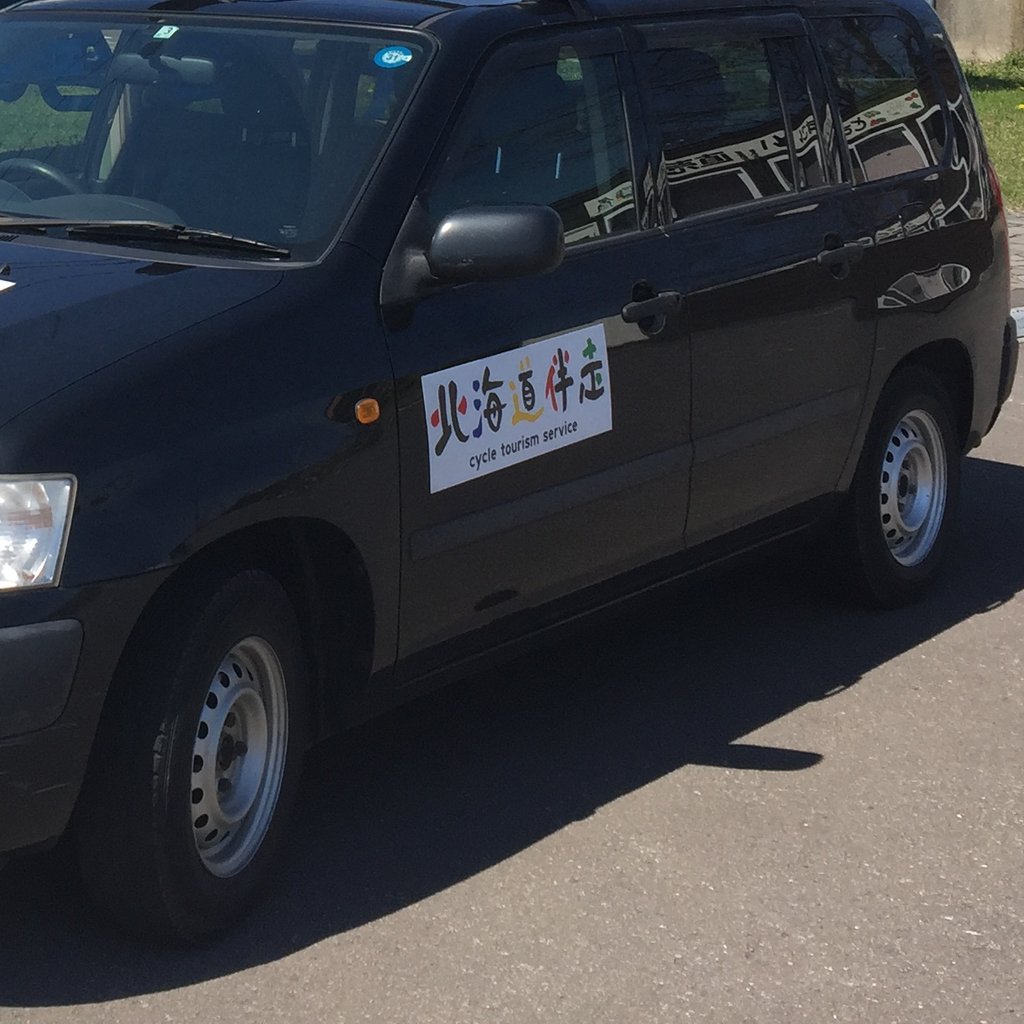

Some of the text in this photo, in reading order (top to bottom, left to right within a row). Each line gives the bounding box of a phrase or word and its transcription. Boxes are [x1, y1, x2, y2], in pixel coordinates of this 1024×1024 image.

[469, 420, 578, 471] cycle tourism service
